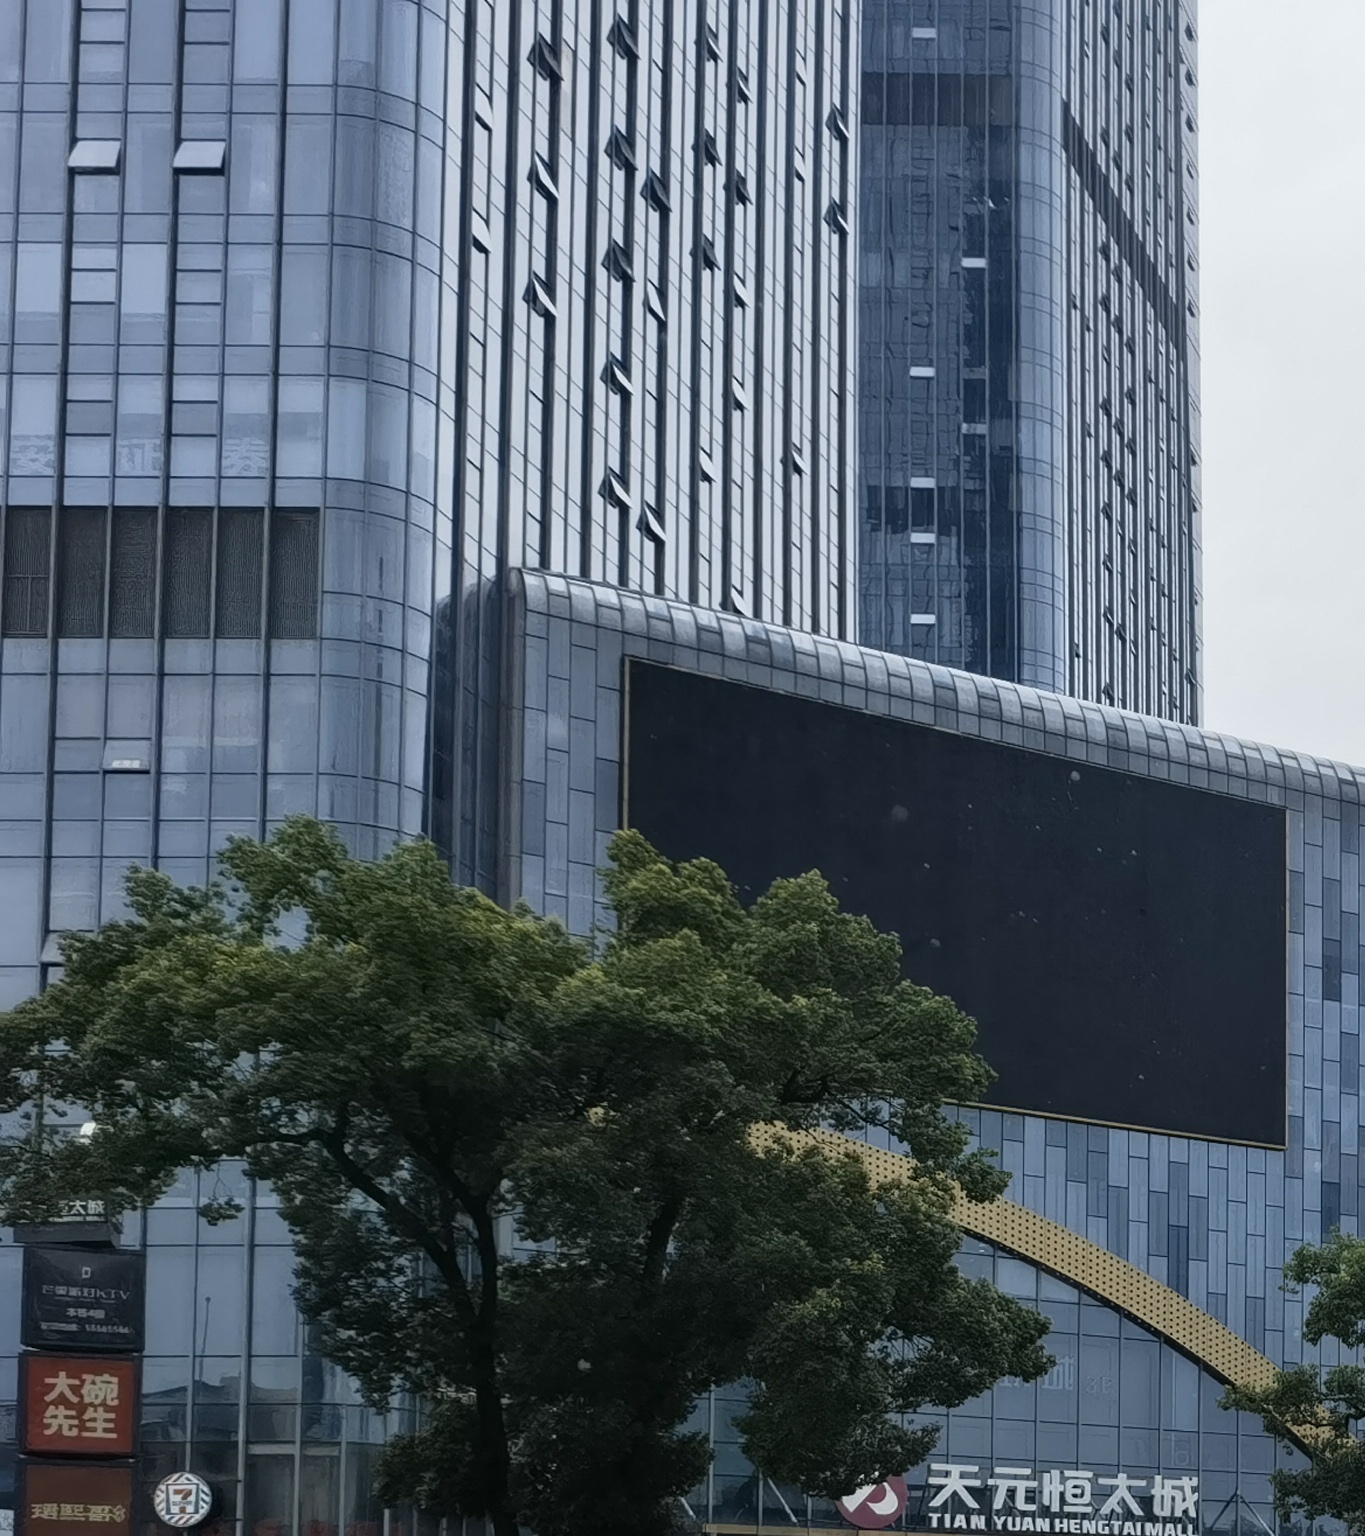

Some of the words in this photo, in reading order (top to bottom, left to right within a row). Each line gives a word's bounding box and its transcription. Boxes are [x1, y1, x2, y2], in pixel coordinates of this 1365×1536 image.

[44, 1371, 120, 1406] 大碗
[43, 1405, 118, 1438] 先生
[927, 1463, 1199, 1518] 天元恒太城
[928, 1513, 987, 1531] TIAN
[991, 1515, 1051, 1533] YUAN
